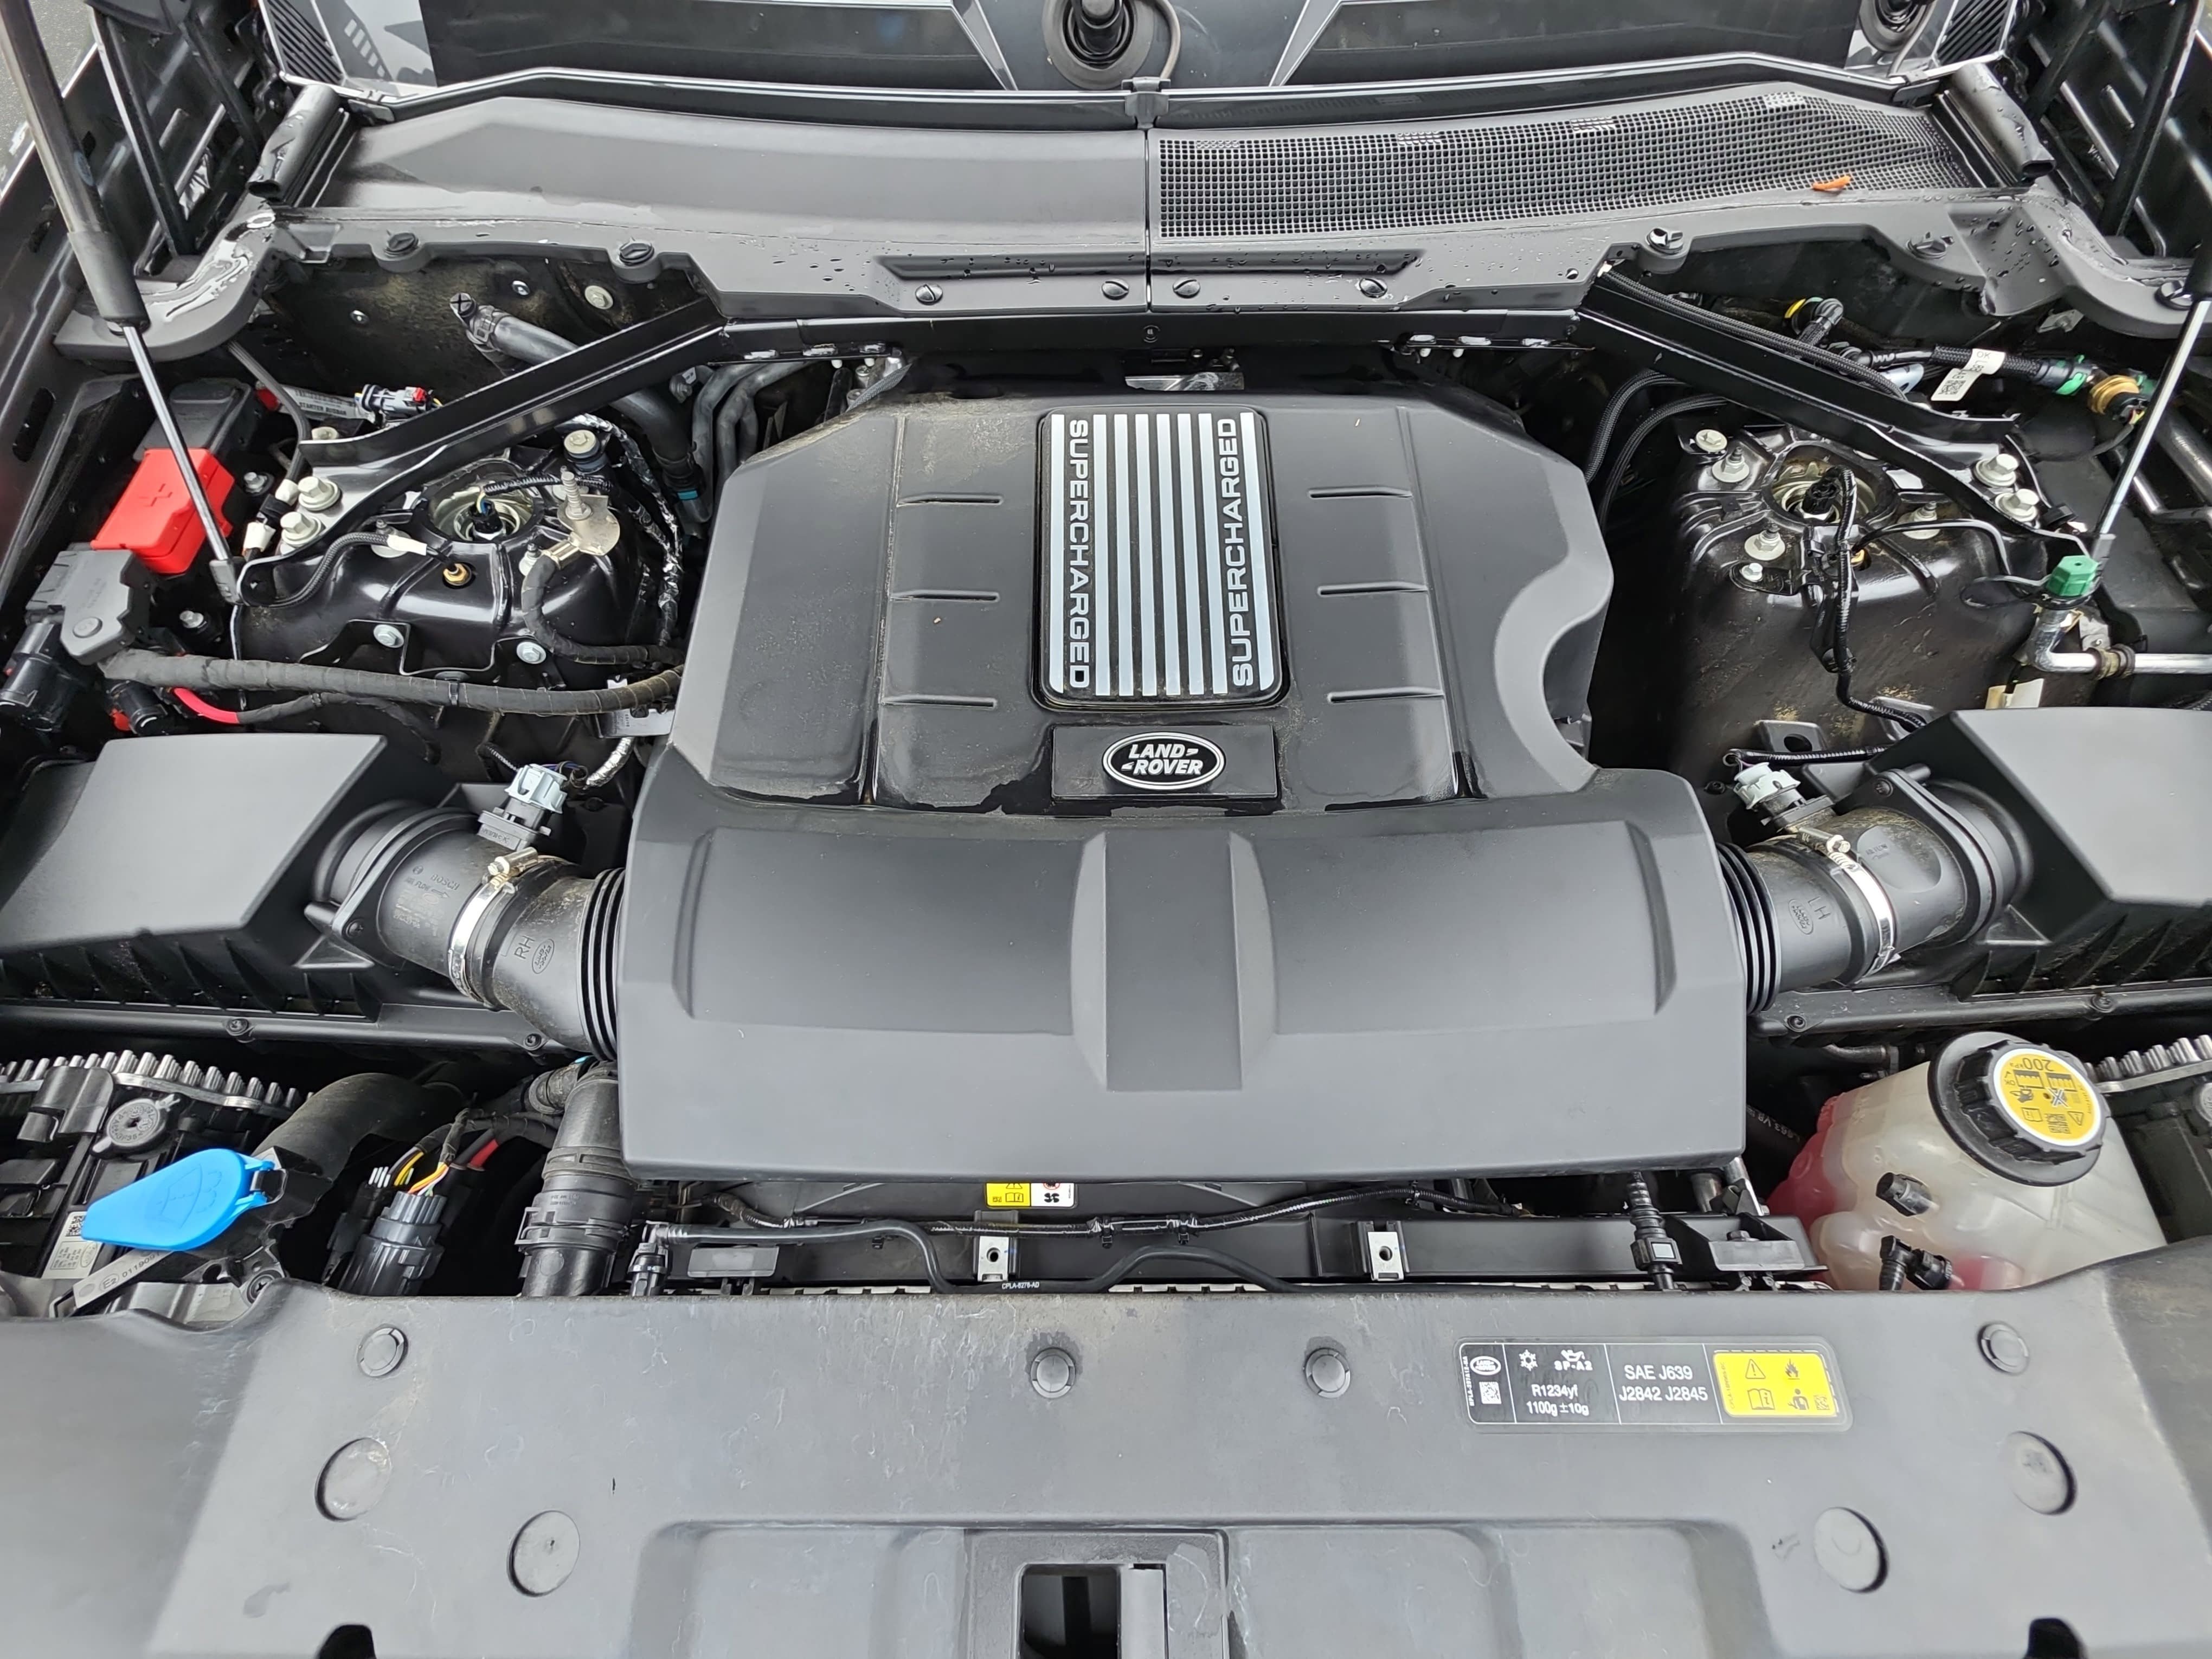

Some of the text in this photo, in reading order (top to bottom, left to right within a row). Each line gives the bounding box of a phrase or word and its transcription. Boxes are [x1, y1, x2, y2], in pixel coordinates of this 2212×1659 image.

[1069, 420, 1089, 689] SUPERCHARGED
[1217, 418, 1254, 687] SUPERCHARGED
[1128, 743, 1186, 759] LAND
[1133, 759, 1204, 775] ROVER
[1808, 896, 1831, 920] LH
[514, 935, 535, 960] RH
[2022, 1058, 2054, 1071] 200
[103, 1278, 117, 1289] E2
[1554, 1361, 1593, 1371] SP-A2
[1624, 1365, 1693, 1380] SAE J639
[1532, 1384, 1578, 1400] R1234yf
[1618, 1386, 1708, 1401] J2842 J2845
[1526, 1401, 1590, 1417] 1100g ±10g
